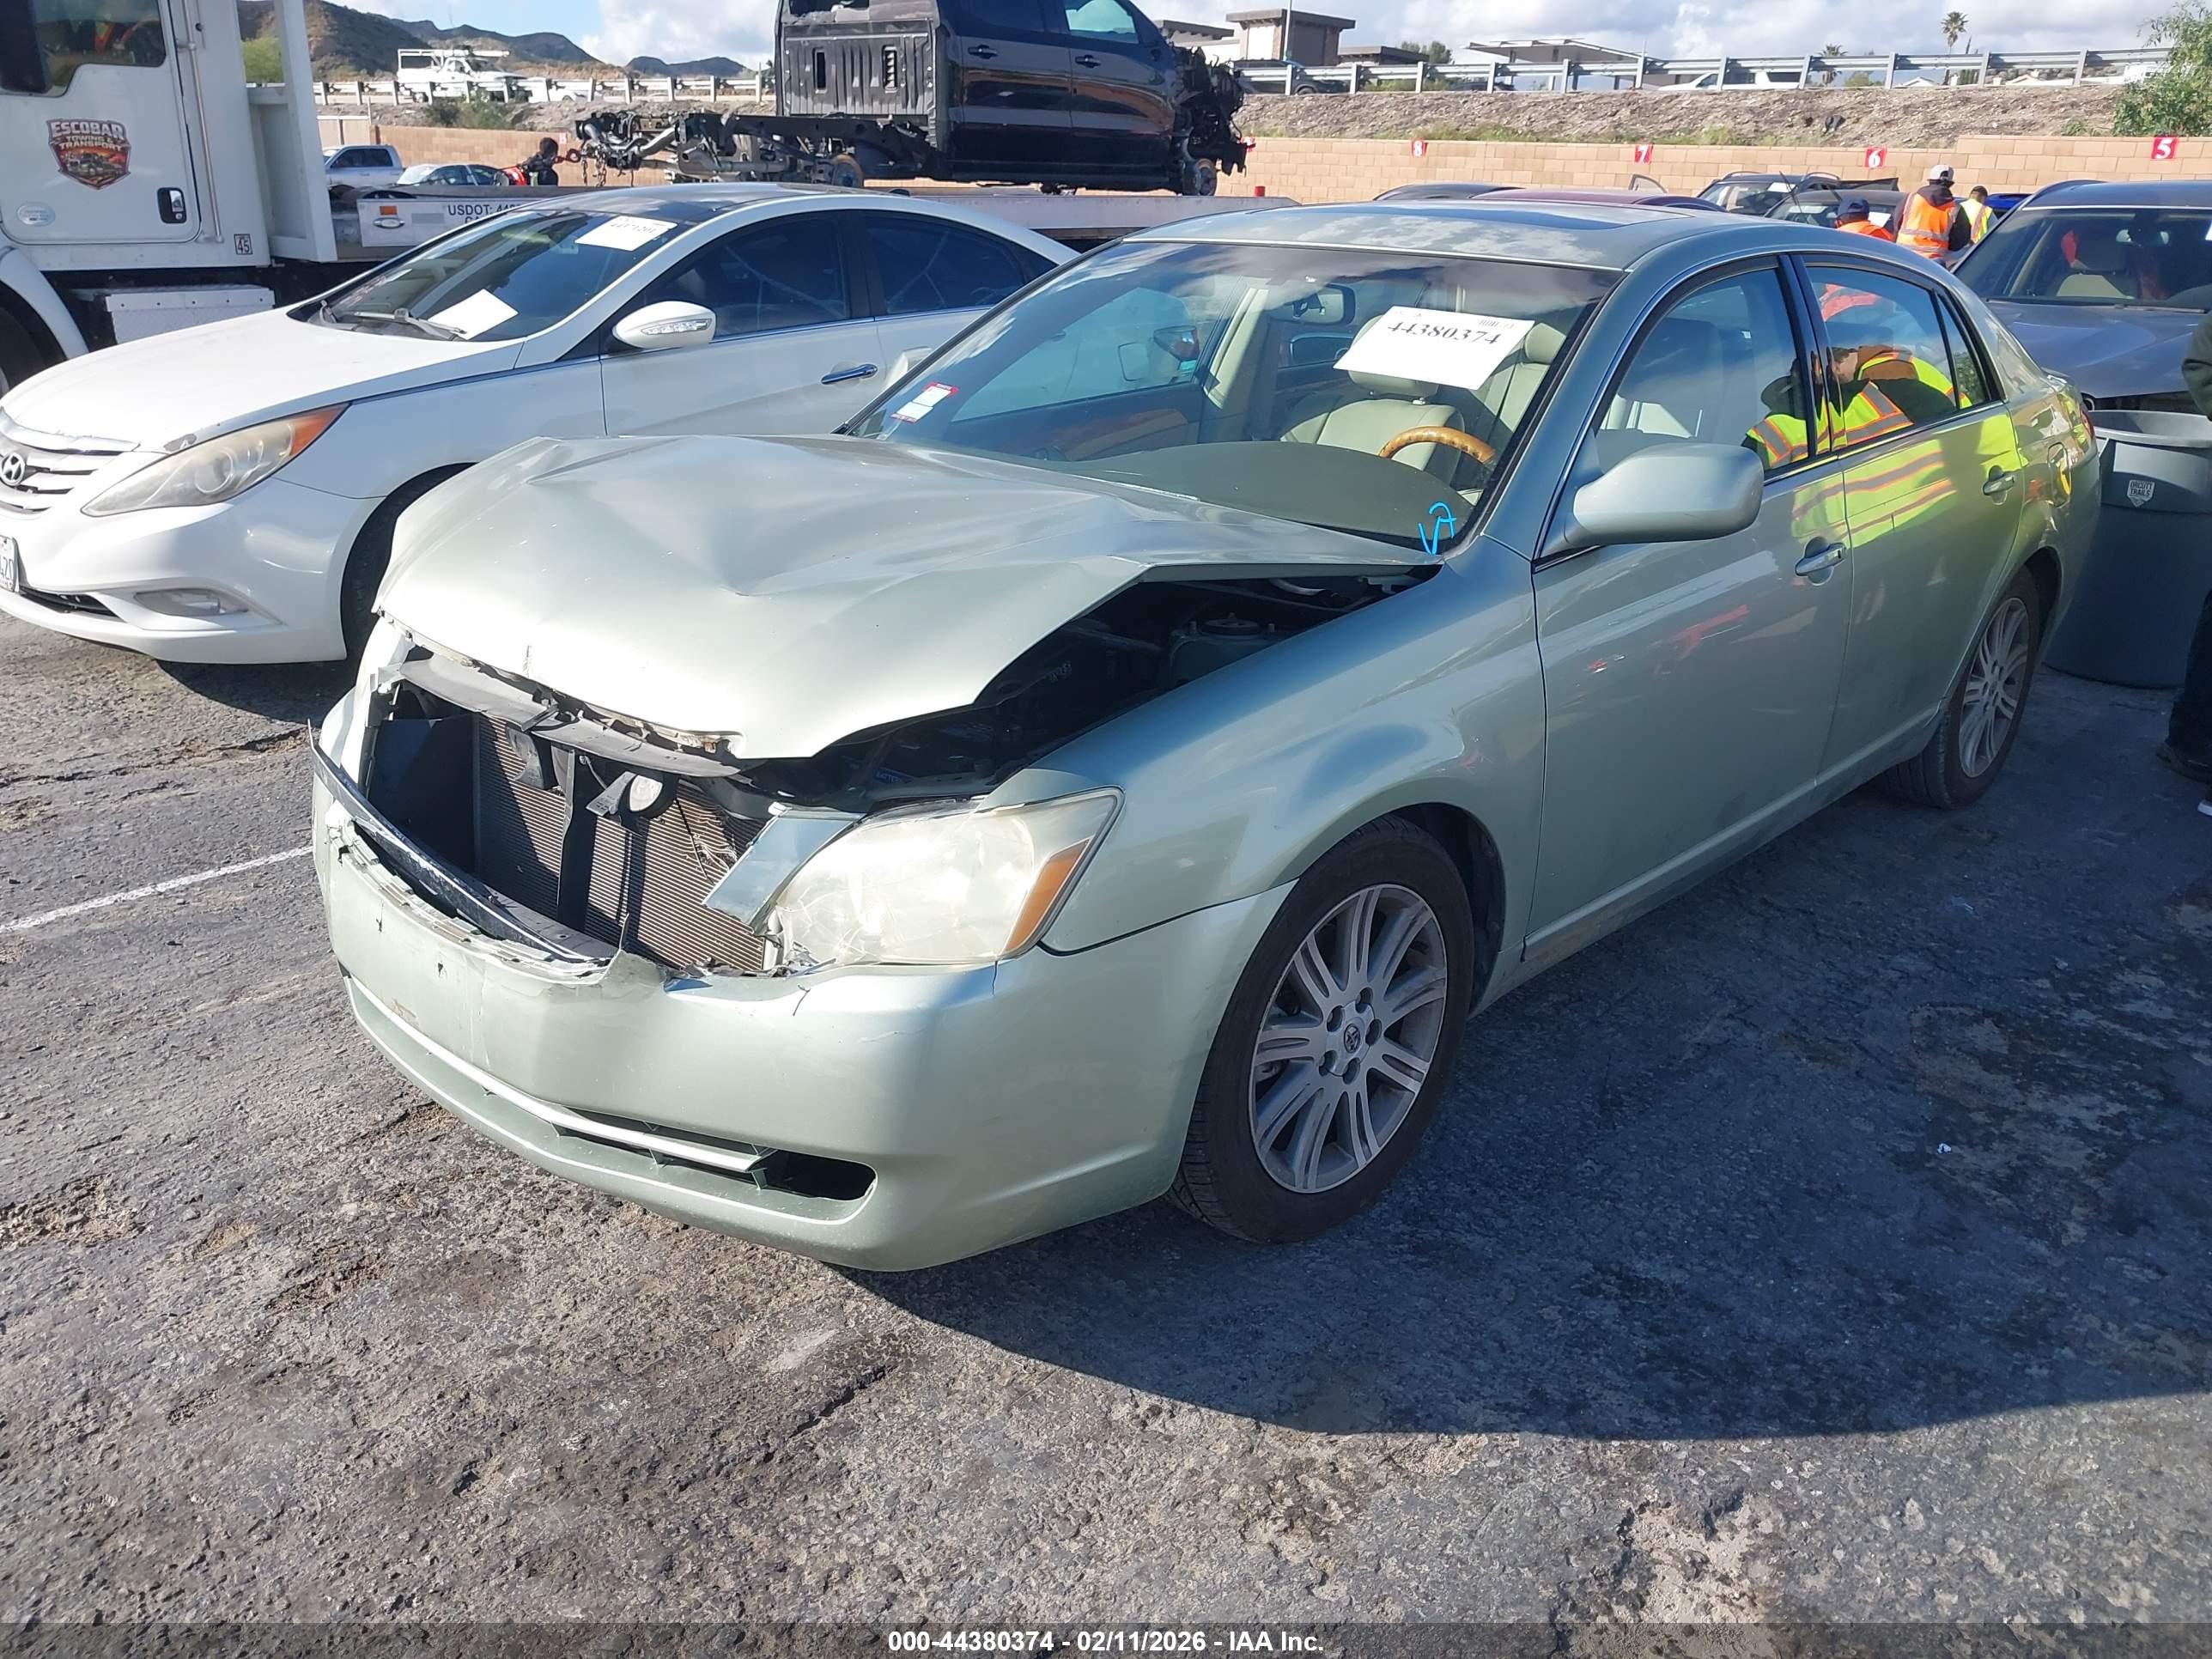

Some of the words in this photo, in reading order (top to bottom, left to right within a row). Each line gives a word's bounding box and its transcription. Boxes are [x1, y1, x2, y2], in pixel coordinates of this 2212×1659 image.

[52, 122, 124, 140] ESCOBAR
[59, 142, 121, 151] TRANSPORT
[1413, 141, 1423, 156] 8
[1637, 144, 1650, 164] 7
[2156, 138, 2172, 159] 5
[1868, 149, 1881, 168] 6
[447, 204, 492, 216] USDOT:
[237, 237, 250, 254] 45
[1388, 322, 1501, 343] 44380374
[2130, 488, 2151, 496] TRAILS
